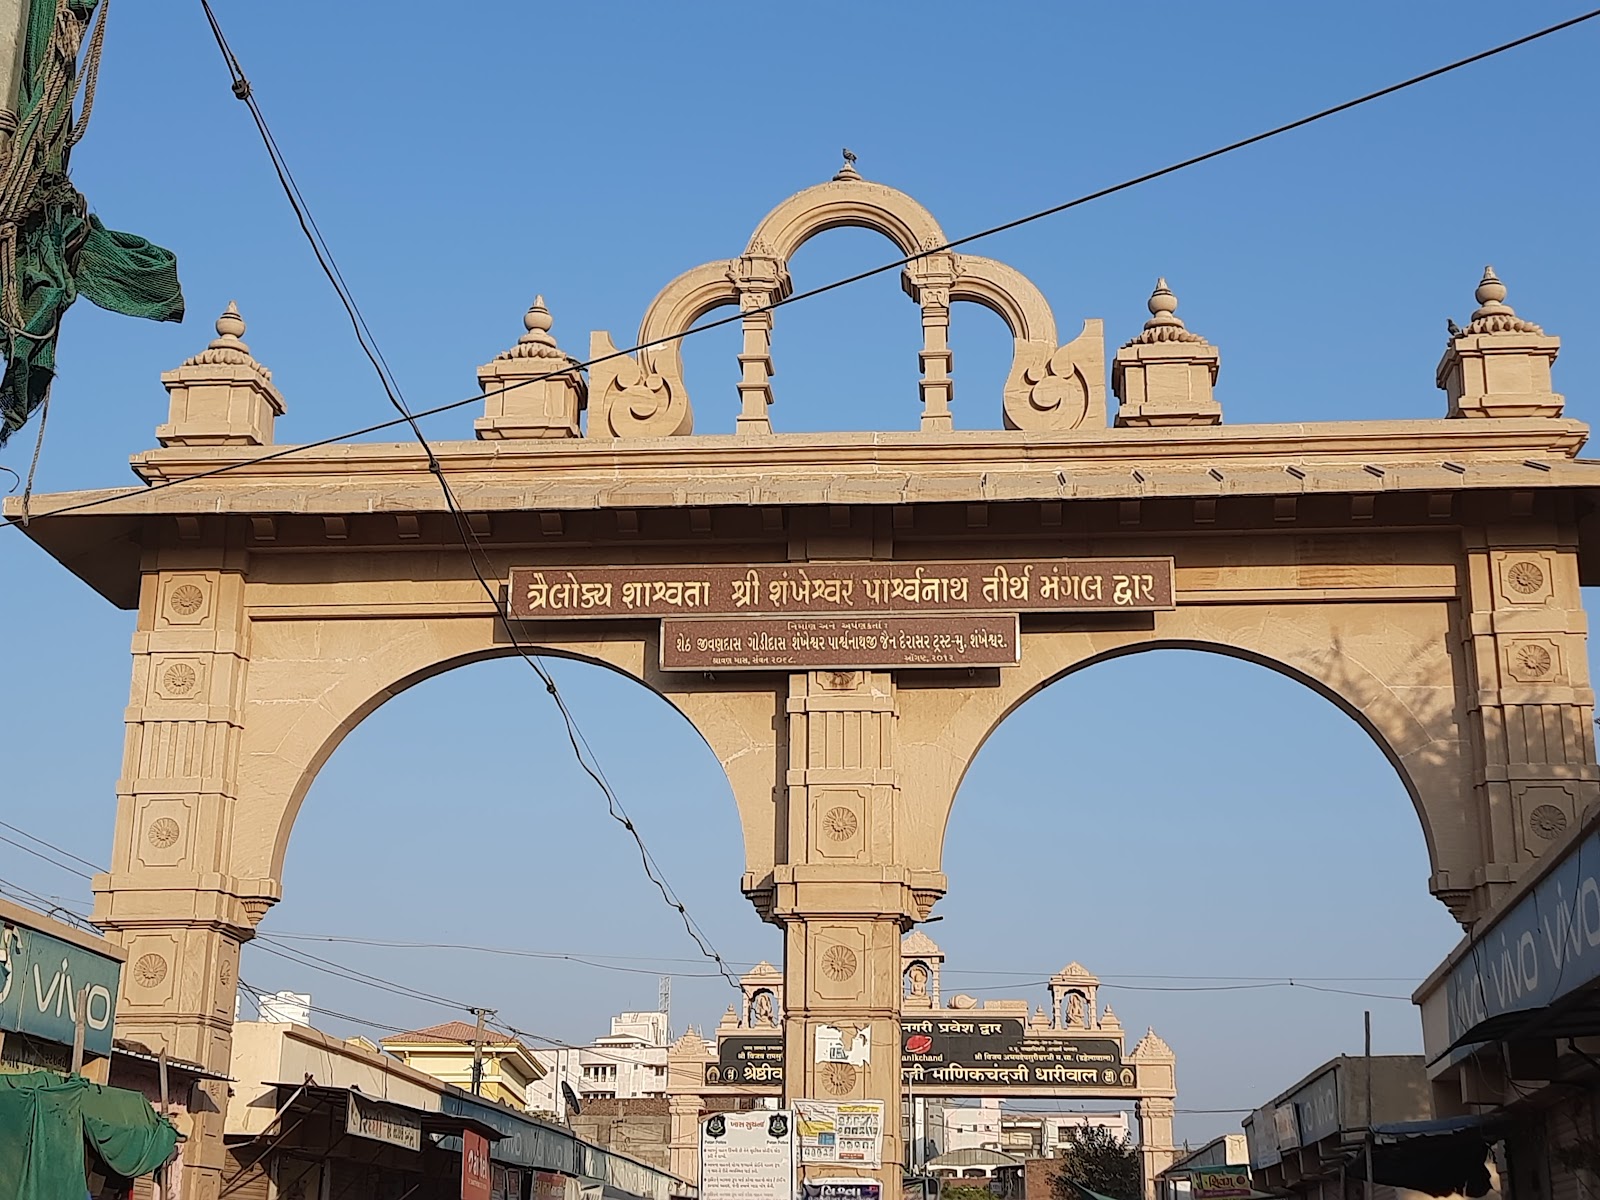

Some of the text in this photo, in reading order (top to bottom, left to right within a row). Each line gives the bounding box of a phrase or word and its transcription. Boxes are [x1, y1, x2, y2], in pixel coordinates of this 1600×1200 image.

[732, 569, 760, 608] શ્રી
[769, 569, 854, 606] શંખેશ્વર
[982, 564, 1033, 603] તીર્થ
[1040, 566, 1103, 601] મંગલ
[1112, 575, 1155, 606] દ્વાર
[676, 633, 691, 652] શેઠ
[697, 635, 742, 652] જીવણદાસ
[791, 631, 826, 651] શંખેશ્વર
[880, 630, 896, 649] જૈન
[899, 630, 930, 649] દેરાસર
[1491, 932, 1537, 1009] vivo
[33, 958, 111, 1031] vivo
[938, 1020, 974, 1034] प्रवेश
[978, 1023, 1002, 1035] द्वार
[1035, 1064, 1098, 1083] धारीवाल
